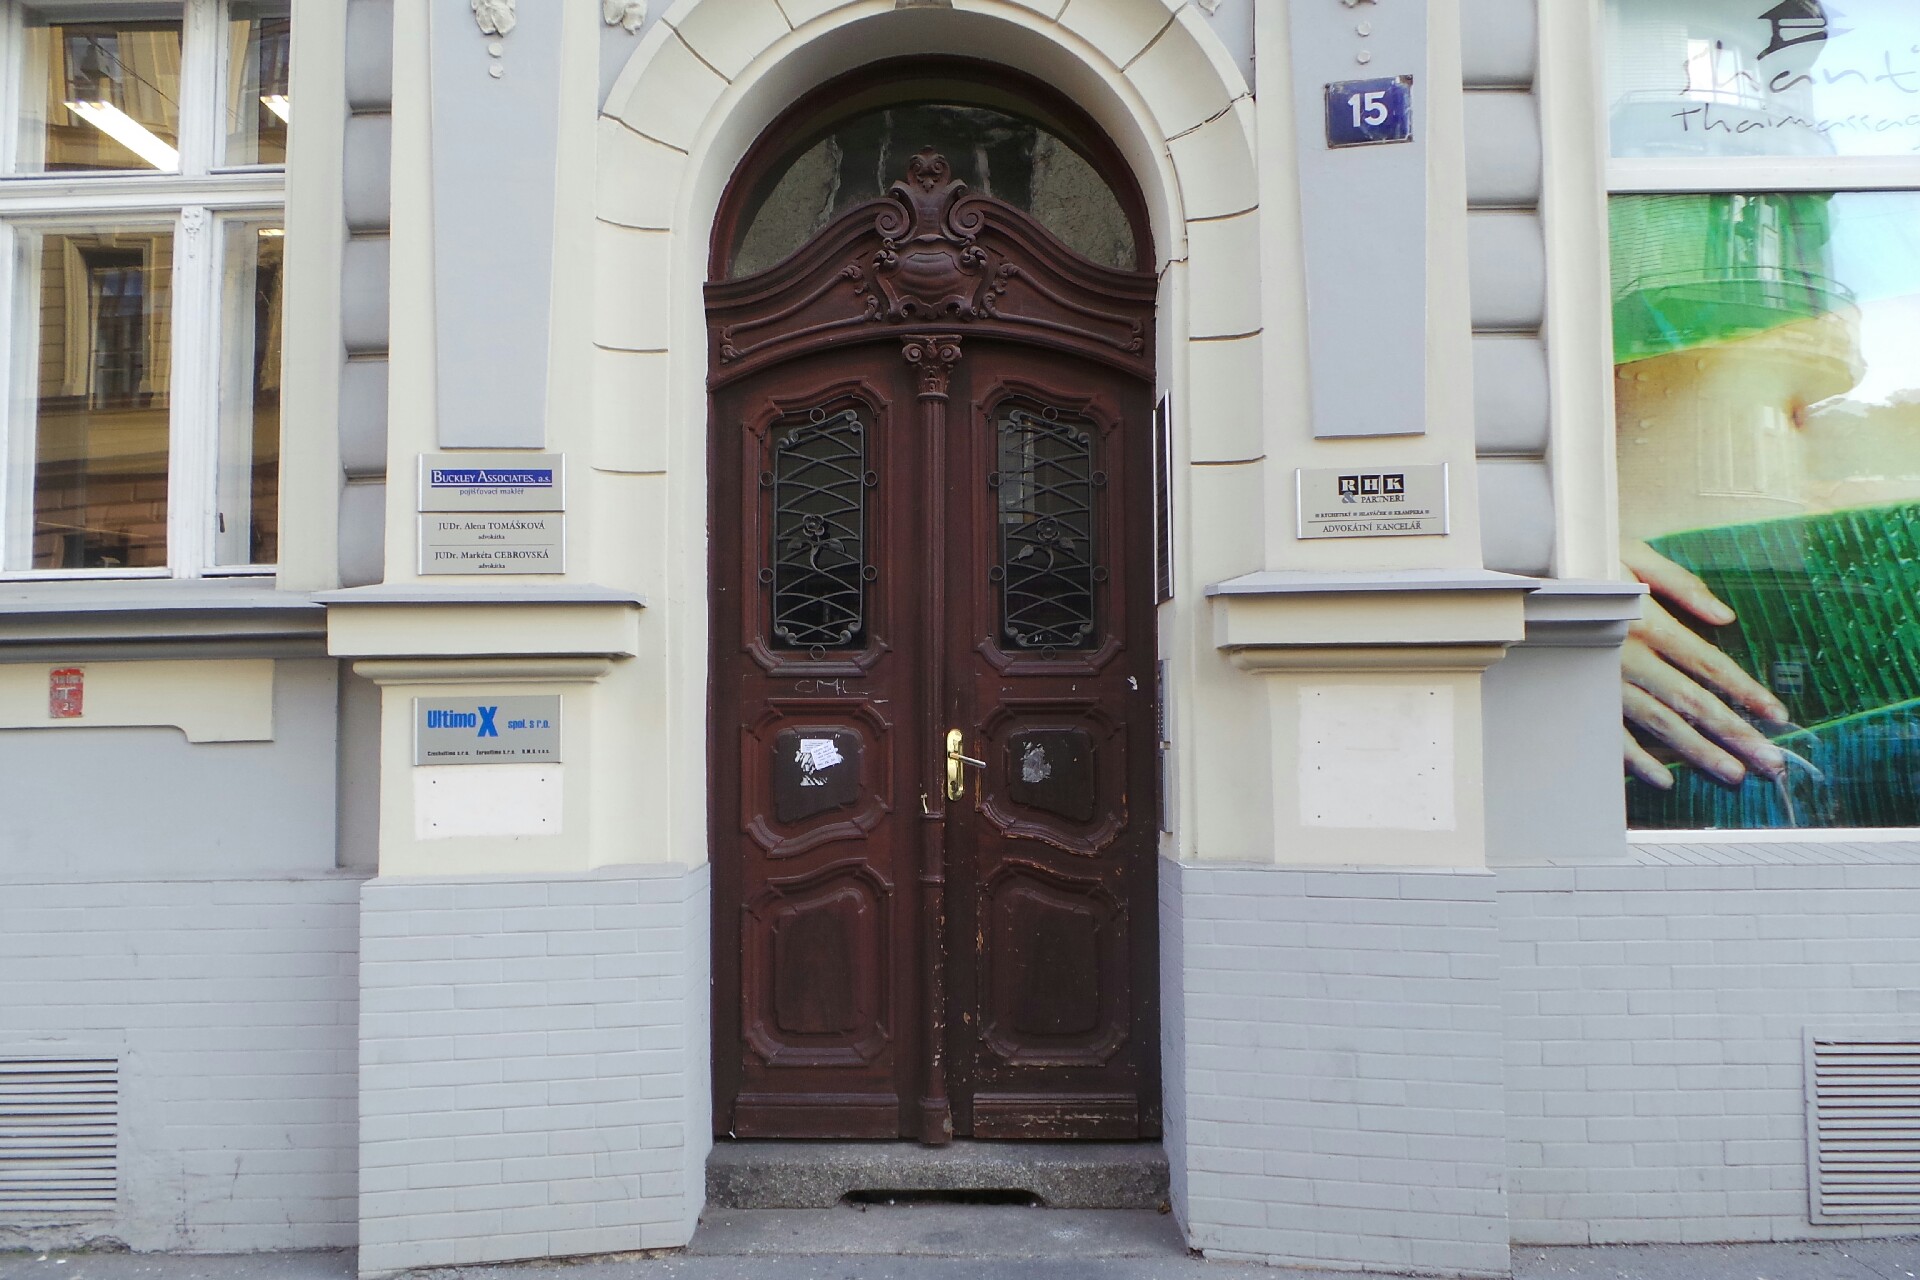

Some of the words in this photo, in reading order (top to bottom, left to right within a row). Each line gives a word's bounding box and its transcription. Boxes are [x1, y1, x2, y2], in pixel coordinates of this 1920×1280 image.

[1347, 90, 1388, 128] 15
[433, 470, 476, 483] BUCKLEY
[538, 475, 551, 483] a.s.
[1340, 476, 1403, 493] RHK
[1341, 491, 1358, 504] &
[438, 522, 462, 531] JUDr.
[465, 521, 486, 530] Alena
[488, 520, 546, 530] TOMÁŠKOVÁ
[1322, 522, 1372, 533] ADVOKÁTNÍ
[1376, 520, 1422, 531] KANCELÁŘ
[435, 551, 458, 560] JUDr.
[461, 550, 492, 559] Markéta
[494, 549, 549, 559] CEBROVSKÁ
